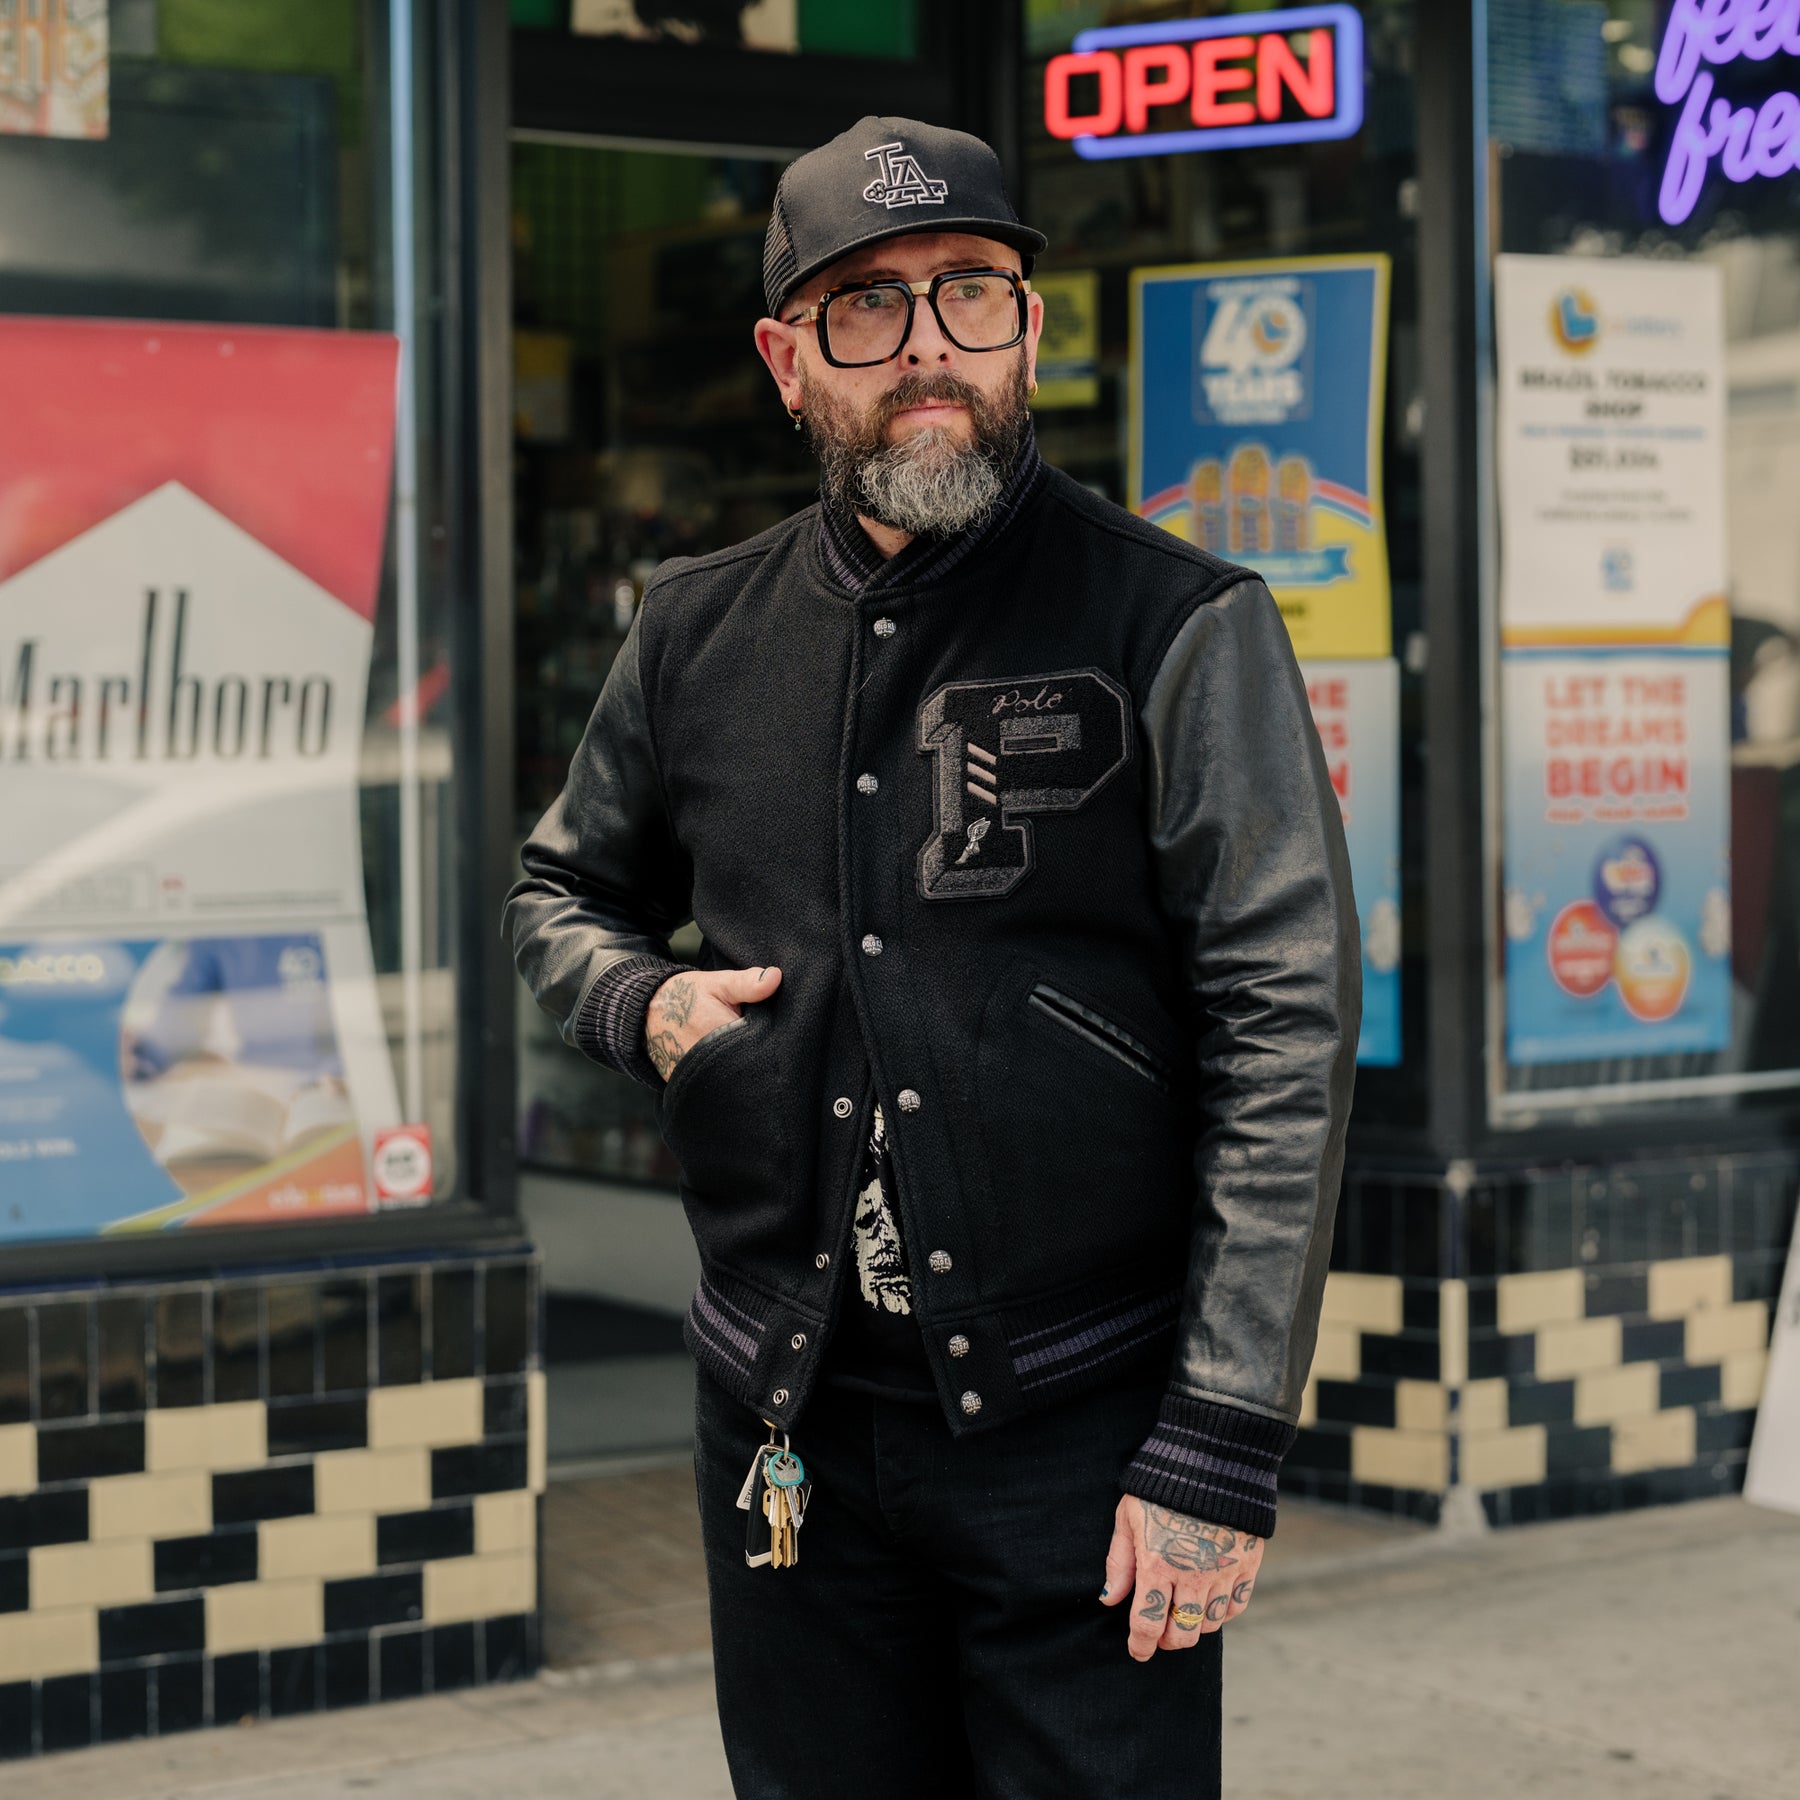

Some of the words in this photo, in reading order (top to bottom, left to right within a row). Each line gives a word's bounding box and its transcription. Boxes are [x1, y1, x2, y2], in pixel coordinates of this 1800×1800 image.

[1045, 29, 1334, 140] OPEN
[1658, 70, 1800, 226] fre
[992, 685, 1072, 714] Polo
[1546, 675, 1604, 708] LET
[1622, 675, 1685, 707] THE
[1546, 718, 1685, 746] DREAMS
[1547, 757, 1687, 797] BEGIN
